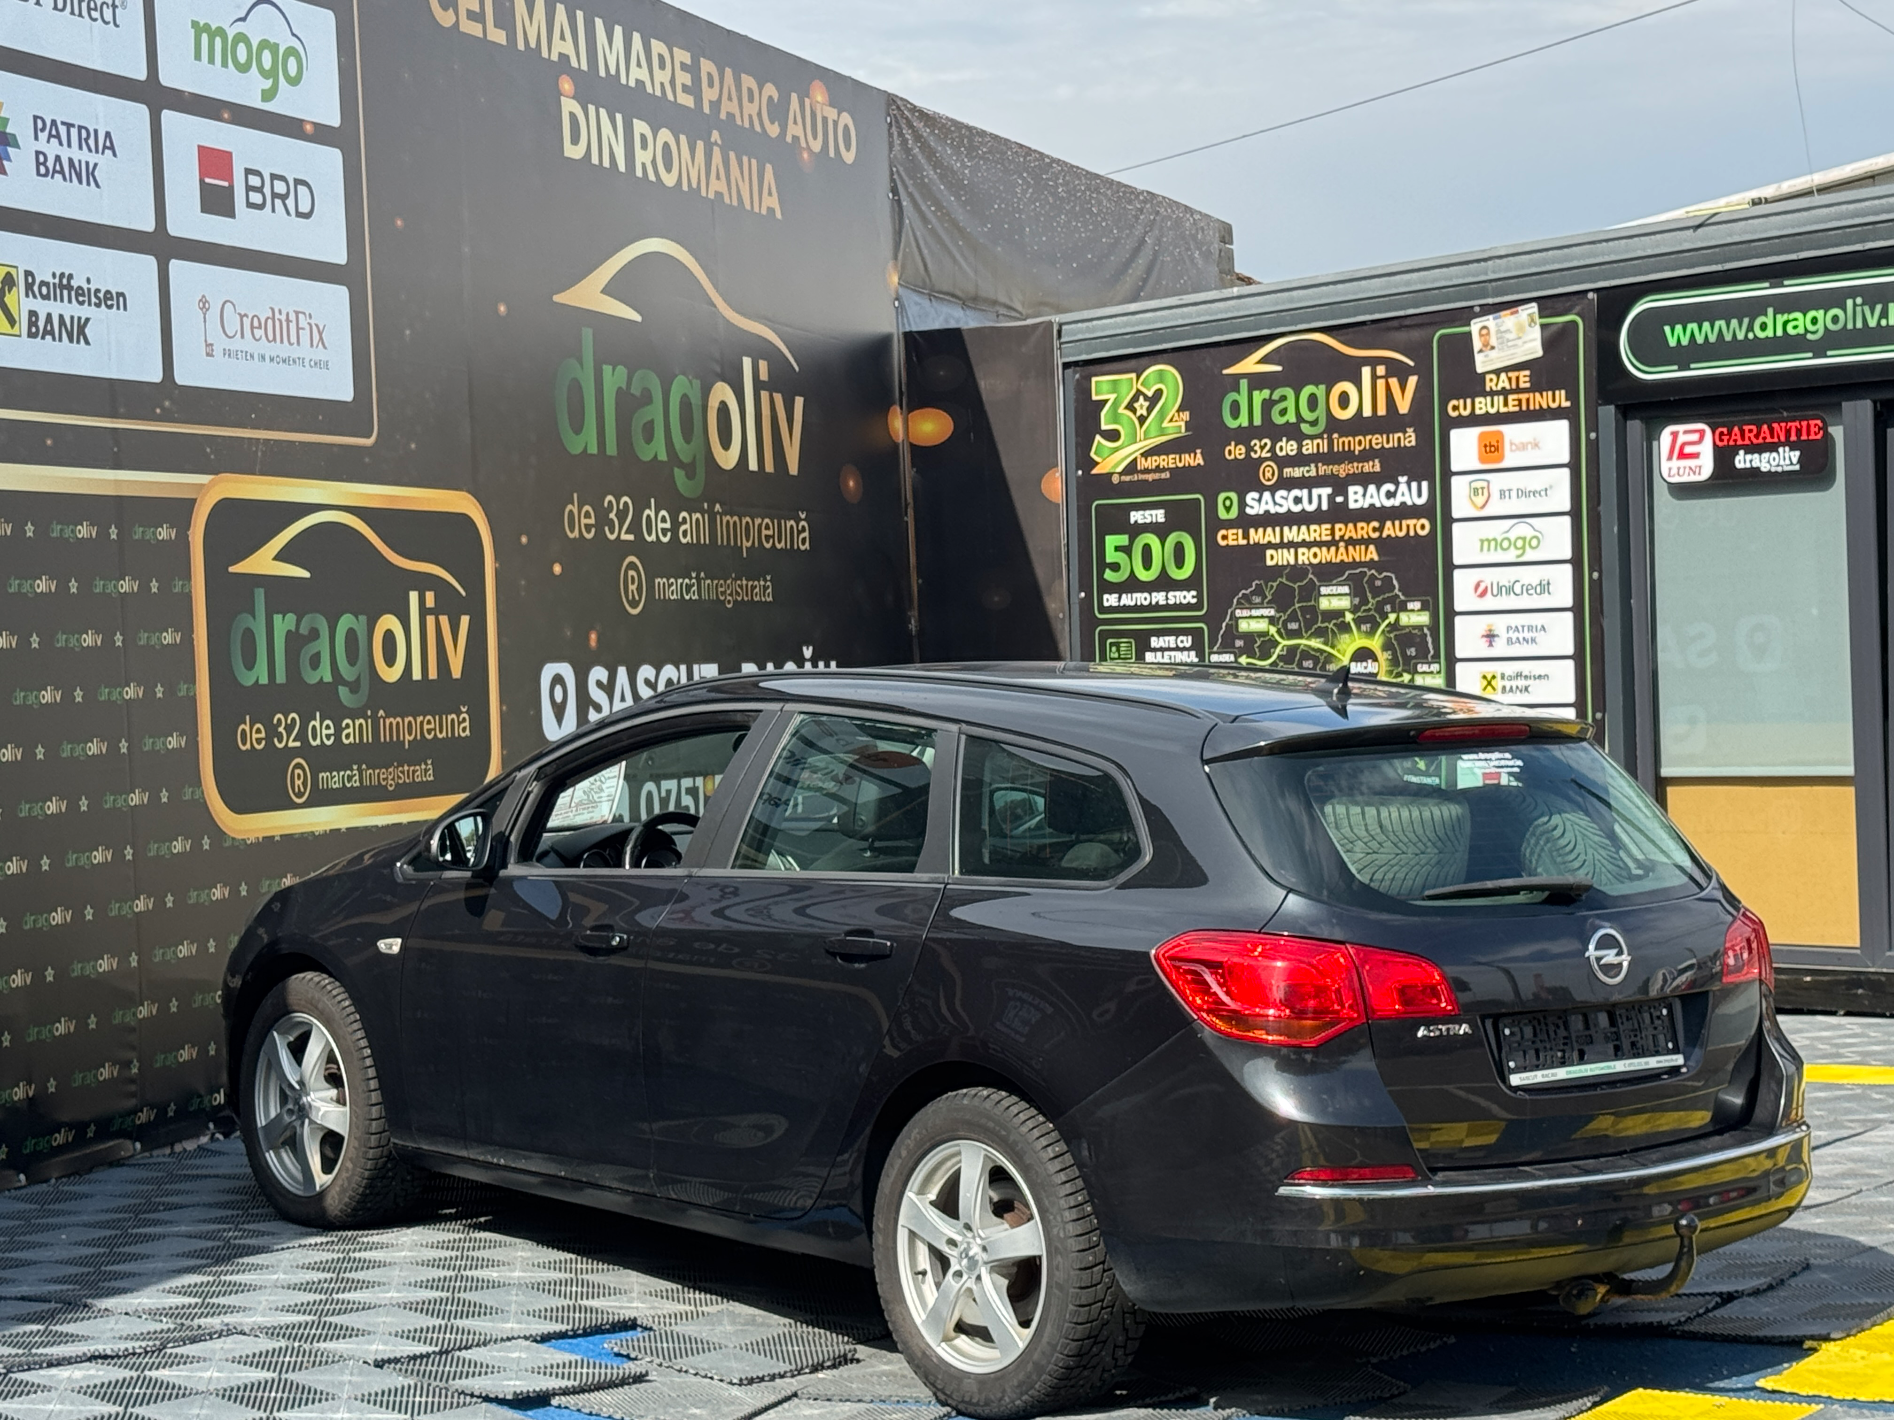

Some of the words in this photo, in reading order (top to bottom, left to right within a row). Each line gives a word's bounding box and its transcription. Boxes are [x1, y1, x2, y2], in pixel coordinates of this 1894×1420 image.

[191, 19, 303, 102] mogo
[429, 0, 507, 45] CEL
[515, 0, 588, 71] MAI
[594, 16, 694, 109] MARE
[700, 57, 780, 139] PARC
[785, 93, 857, 165] AUTO
[33, 114, 117, 158] PATRIA
[34, 150, 101, 189] BANK
[560, 95, 626, 173] DIN
[633, 118, 782, 220] ROMÂNIA
[244, 167, 315, 220] BRD
[24, 270, 127, 312] Raiffeisen
[27, 310, 91, 346] BANK
[219, 299, 328, 350] CreditFix
[222, 347, 255, 361] PRIETEN
[258, 352, 266, 363] IN
[269, 355, 306, 368] MOMENTE
[308, 359, 330, 371] CHEIE
[1485, 370, 1531, 392] RATE
[554, 327, 804, 499] dragoliv
[1090, 364, 1185, 462] 32
[1222, 365, 1418, 435] dragoliv
[1447, 397, 1472, 418] CU
[1474, 389, 1571, 416] BULETINUL
[1224, 441, 1246, 460] de
[1250, 438, 1272, 458] 32
[1275, 437, 1297, 456] de
[1302, 433, 1328, 455] ani
[1332, 427, 1416, 455] împreună
[1483, 440, 1500, 455] tbi
[1509, 438, 1541, 453] bank
[1666, 428, 1706, 461] 12
[1714, 419, 1824, 447] GARANTIE
[1283, 463, 1316, 478] marcă
[1318, 458, 1381, 477] înregistrată
[1668, 465, 1702, 478] LUNI
[1735, 446, 1800, 472] dragoliv
[1245, 487, 1332, 515] SASCUT
[1348, 476, 1429, 510] BACĂU
[1473, 487, 1486, 497] BT
[1499, 488, 1513, 500] BT
[1516, 486, 1549, 499] Direct
[50, 521, 98, 542] dragoliv
[132, 524, 177, 543] dragoliv
[564, 492, 595, 539] de
[603, 494, 635, 541] 32
[642, 498, 672, 543] de
[678, 503, 710, 545] ani
[714, 503, 810, 558] împreună
[1130, 509, 1166, 525] PESTE
[1216, 528, 1248, 546] CEL
[1249, 526, 1281, 545] MAI
[1283, 523, 1331, 543] MARE
[1334, 520, 1379, 541] PARC
[1382, 518, 1431, 538] AUTO
[1103, 531, 1196, 583] 500
[1265, 548, 1295, 566] DIN
[1297, 541, 1379, 565] ROMÂNIA
[1479, 535, 1541, 558] mogo
[7, 575, 57, 597] dragoliv
[93, 576, 139, 597] dragoliv
[654, 571, 698, 600] marcă
[701, 571, 773, 608] înregistrată
[1103, 593, 1119, 607] DE
[1120, 592, 1151, 606] AUTO
[1151, 591, 1167, 605] PE
[1167, 590, 1198, 604] STOC
[1490, 579, 1551, 597] UniCredit
[54, 630, 102, 652] dragoliv
[137, 628, 181, 649] dragoliv
[1150, 636, 1176, 648] RATE
[1177, 635, 1193, 648] CU
[1506, 624, 1547, 635] PATRIA
[1506, 636, 1538, 646] BANK
[230, 587, 470, 708] dragoliv
[1145, 651, 1199, 663] BULETINUL
[1350, 659, 1379, 674] BACĂU
[1500, 671, 1550, 682] Raiffeisen
[12, 686, 62, 709] dragoliv
[98, 683, 144, 704] dragoliv
[588, 663, 719, 722] SAS
[1501, 685, 1531, 694] BANK
[237, 715, 266, 751] de
[273, 712, 301, 748] 32
[308, 711, 335, 747] de
[341, 710, 372, 743] ani
[378, 706, 470, 749] împreună
[60, 738, 108, 760] dragoliv
[142, 732, 187, 753] dragoliv
[319, 762, 359, 789] marcă
[361, 759, 434, 790] înregistrată
[18, 797, 67, 819] dragoliv
[103, 789, 149, 810] dragoliv
[65, 846, 113, 869] dragoliv
[147, 836, 192, 858] dragoliv
[24, 906, 72, 930] dragoliv
[107, 895, 154, 917] dragoliv
[187, 884, 230, 904] dragoliv
[70, 954, 118, 977] dragoliv
[153, 940, 197, 962] dragoliv
[26, 1017, 76, 1042] dragoliv
[112, 1001, 158, 1025] dragoliv
[1417, 1023, 1472, 1038] ASTRA
[71, 1062, 119, 1087] dragoliv
[154, 1044, 198, 1068] dragoliv
[22, 1128, 75, 1153] dragoliv
[110, 1107, 157, 1132] dragoliv
